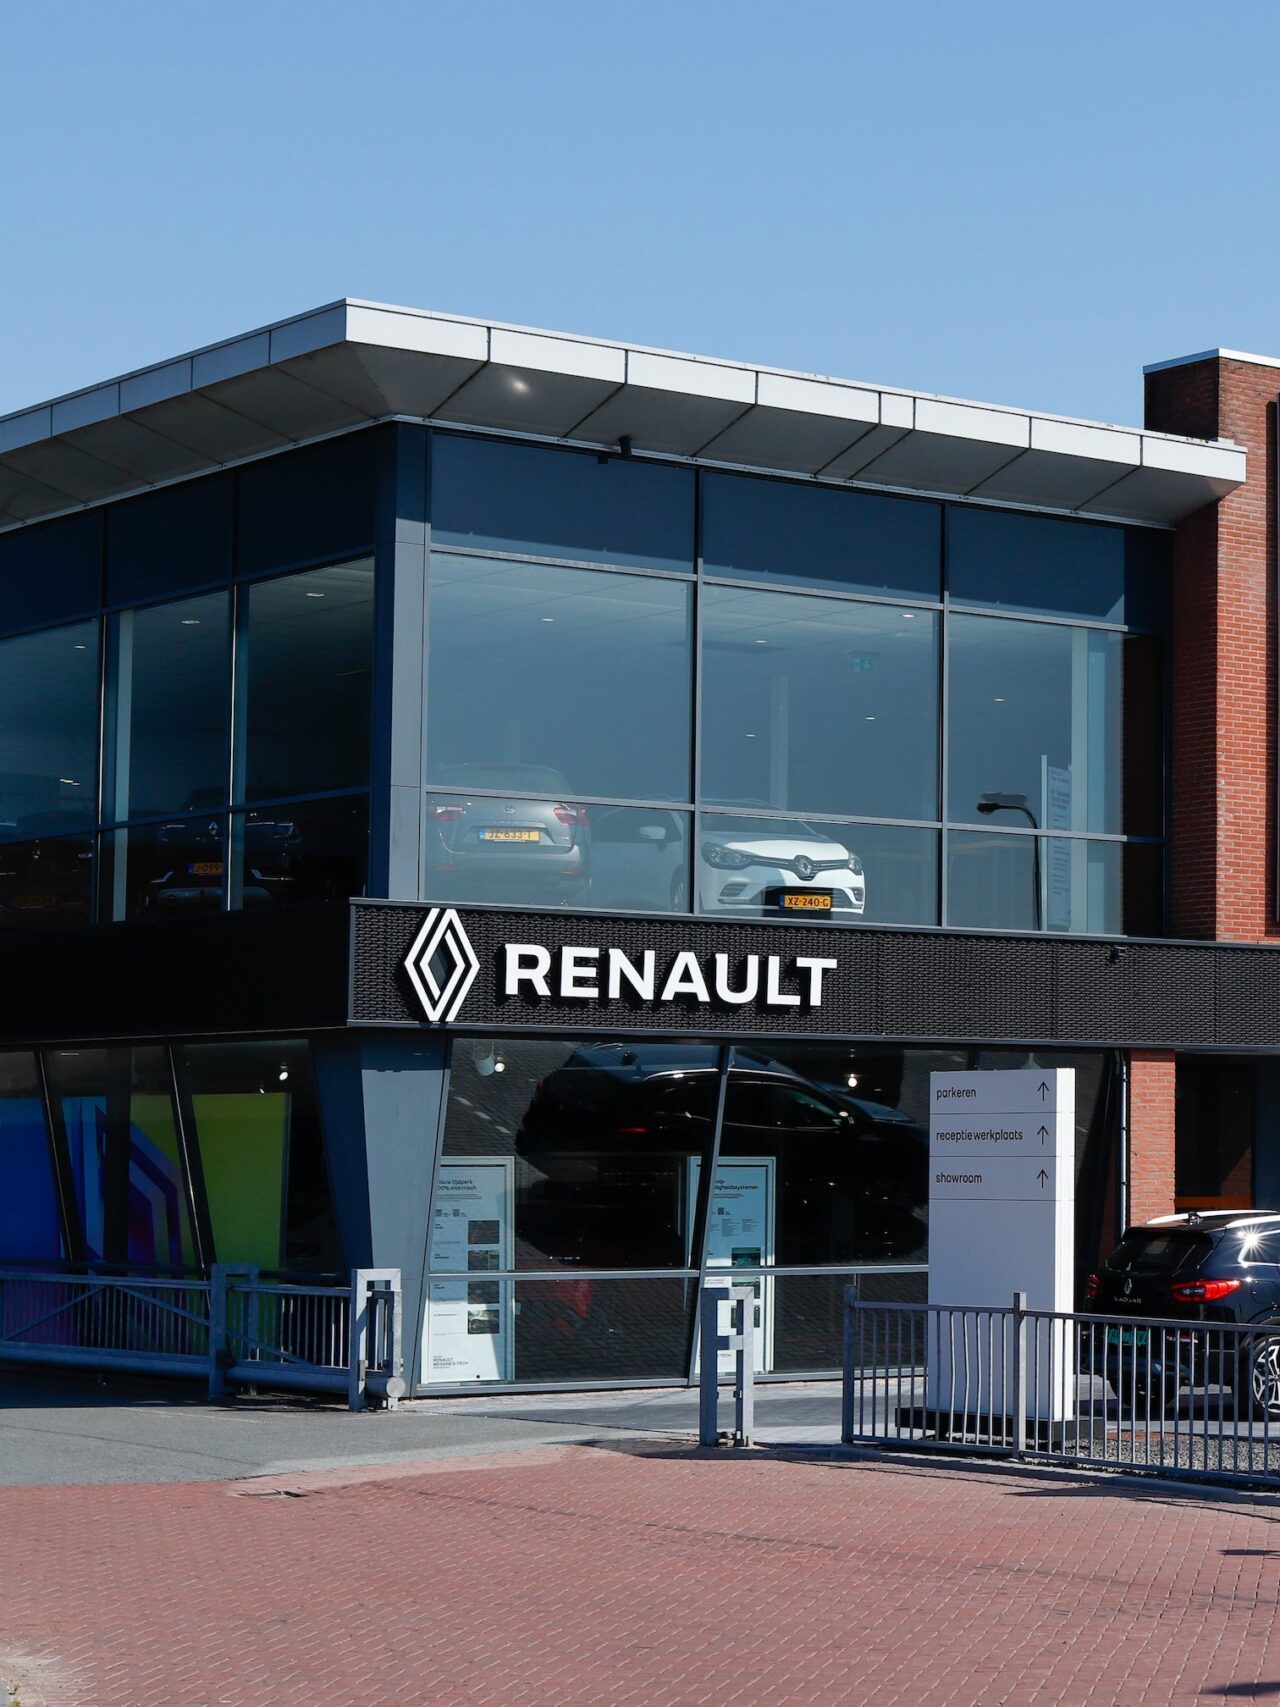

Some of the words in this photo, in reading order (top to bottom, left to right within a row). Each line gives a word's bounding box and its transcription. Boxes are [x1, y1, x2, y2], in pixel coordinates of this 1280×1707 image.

[787, 896, 829, 907] XZ-240-G
[504, 942, 838, 1008] RENAULT
[936, 1087, 977, 1101] parkeren
[936, 1129, 973, 1143] receptie
[973, 1129, 1023, 1143] werkplaats
[935, 1172, 982, 1184] showroom
